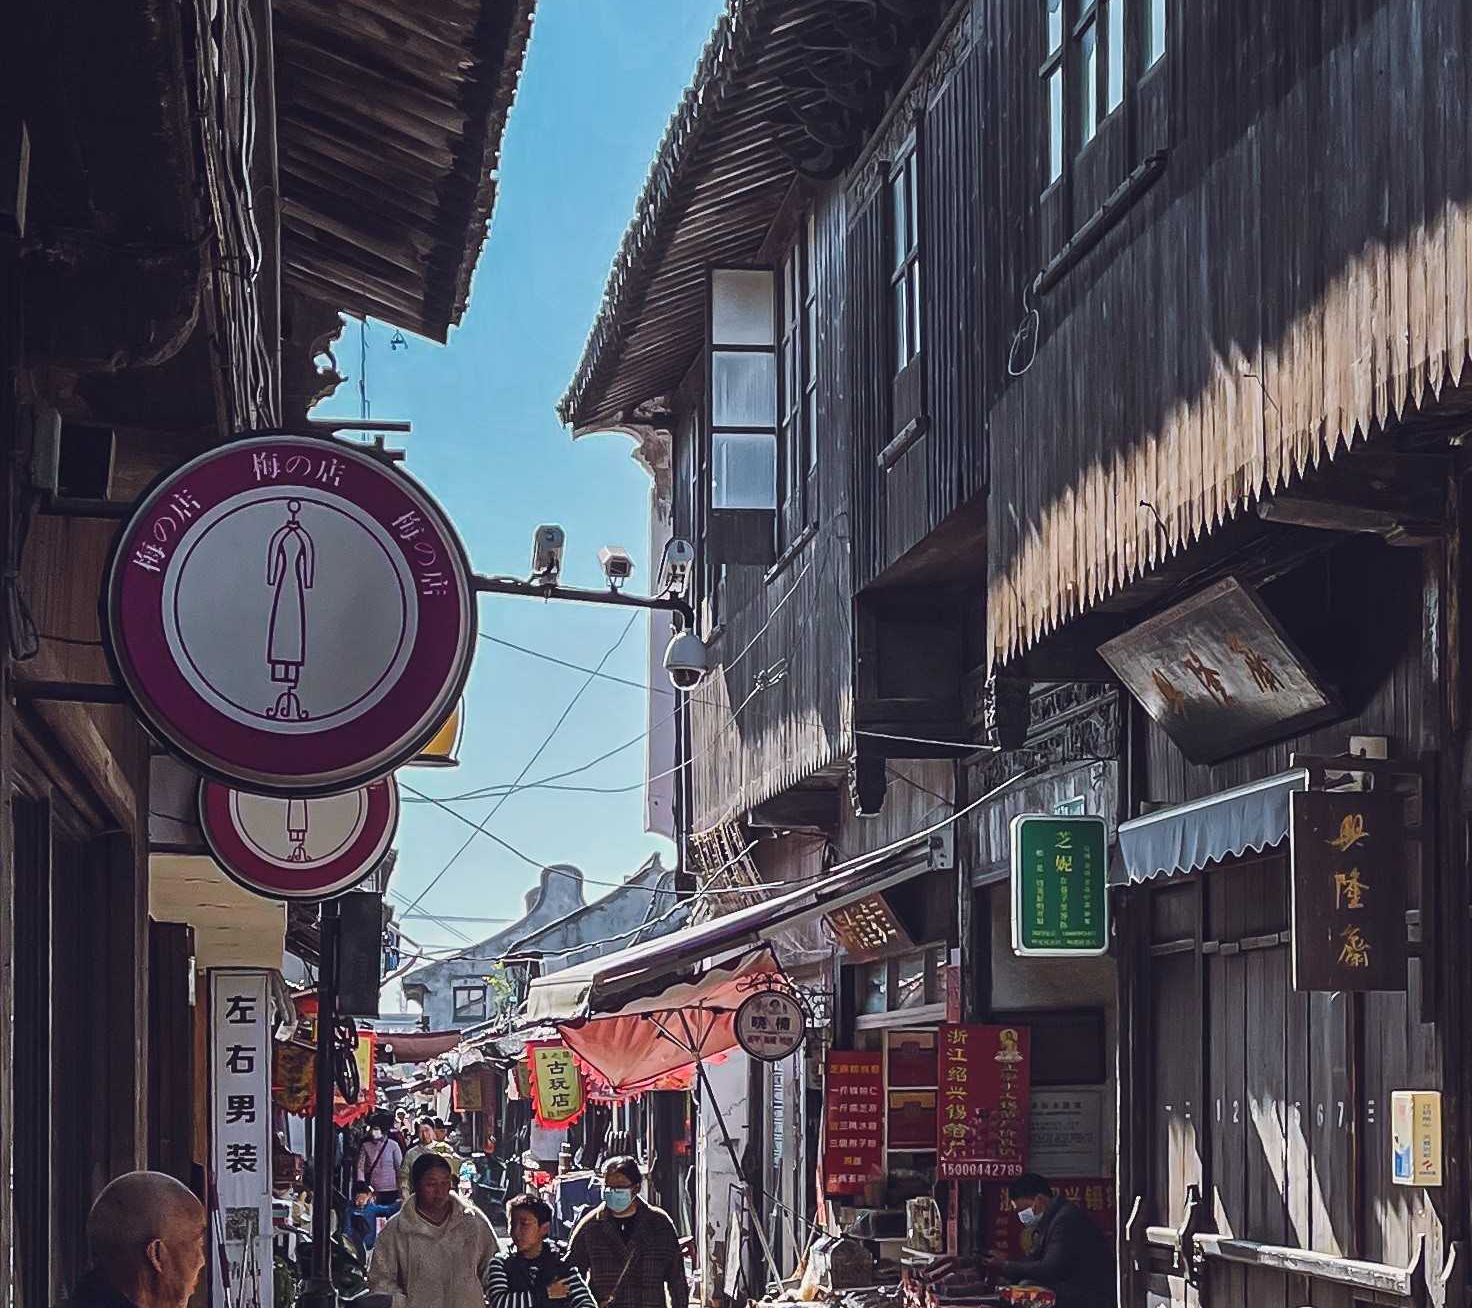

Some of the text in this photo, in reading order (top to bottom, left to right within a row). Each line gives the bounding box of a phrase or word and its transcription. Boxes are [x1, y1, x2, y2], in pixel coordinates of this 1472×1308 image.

[253, 452, 346, 487] 梅の店
[132, 489, 201, 573] 梅の店
[391, 510, 449, 596] 梅の店
[225, 995, 257, 1174] 左右男装
[546, 1061, 570, 1108] 古玩店
[1316, 1103, 1324, 1128] 6
[1337, 1101, 1344, 1128] 7
